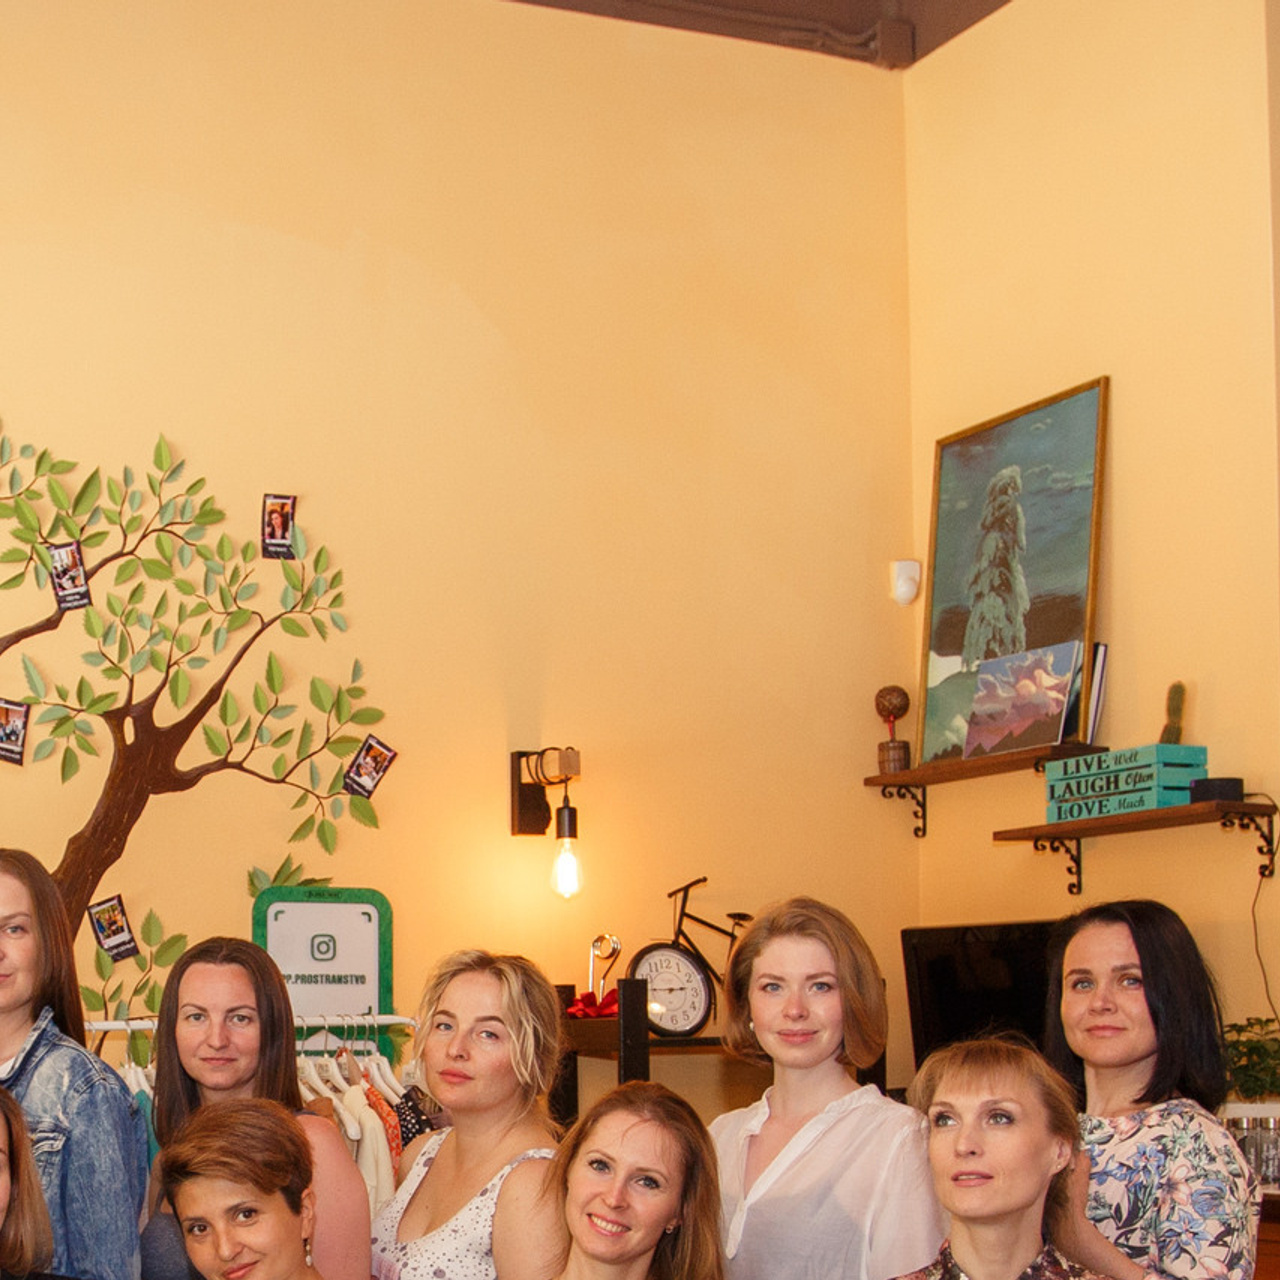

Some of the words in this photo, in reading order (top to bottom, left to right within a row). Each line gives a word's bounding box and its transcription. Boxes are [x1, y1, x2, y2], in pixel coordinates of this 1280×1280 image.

[1063, 754, 1110, 776] LIVE
[1049, 774, 1120, 800] LAUGH
[1124, 771, 1154, 787] Often
[1057, 798, 1111, 821] LOVE
[1114, 796, 1145, 811] Much
[648, 961, 659, 973] 11
[660, 959, 672, 970] 12
[685, 972, 694, 984] 2
[691, 987, 699, 999] 3
[689, 1000, 697, 1012] 4
[671, 1014, 679, 1026] 6
[682, 1010, 690, 1021] 5
